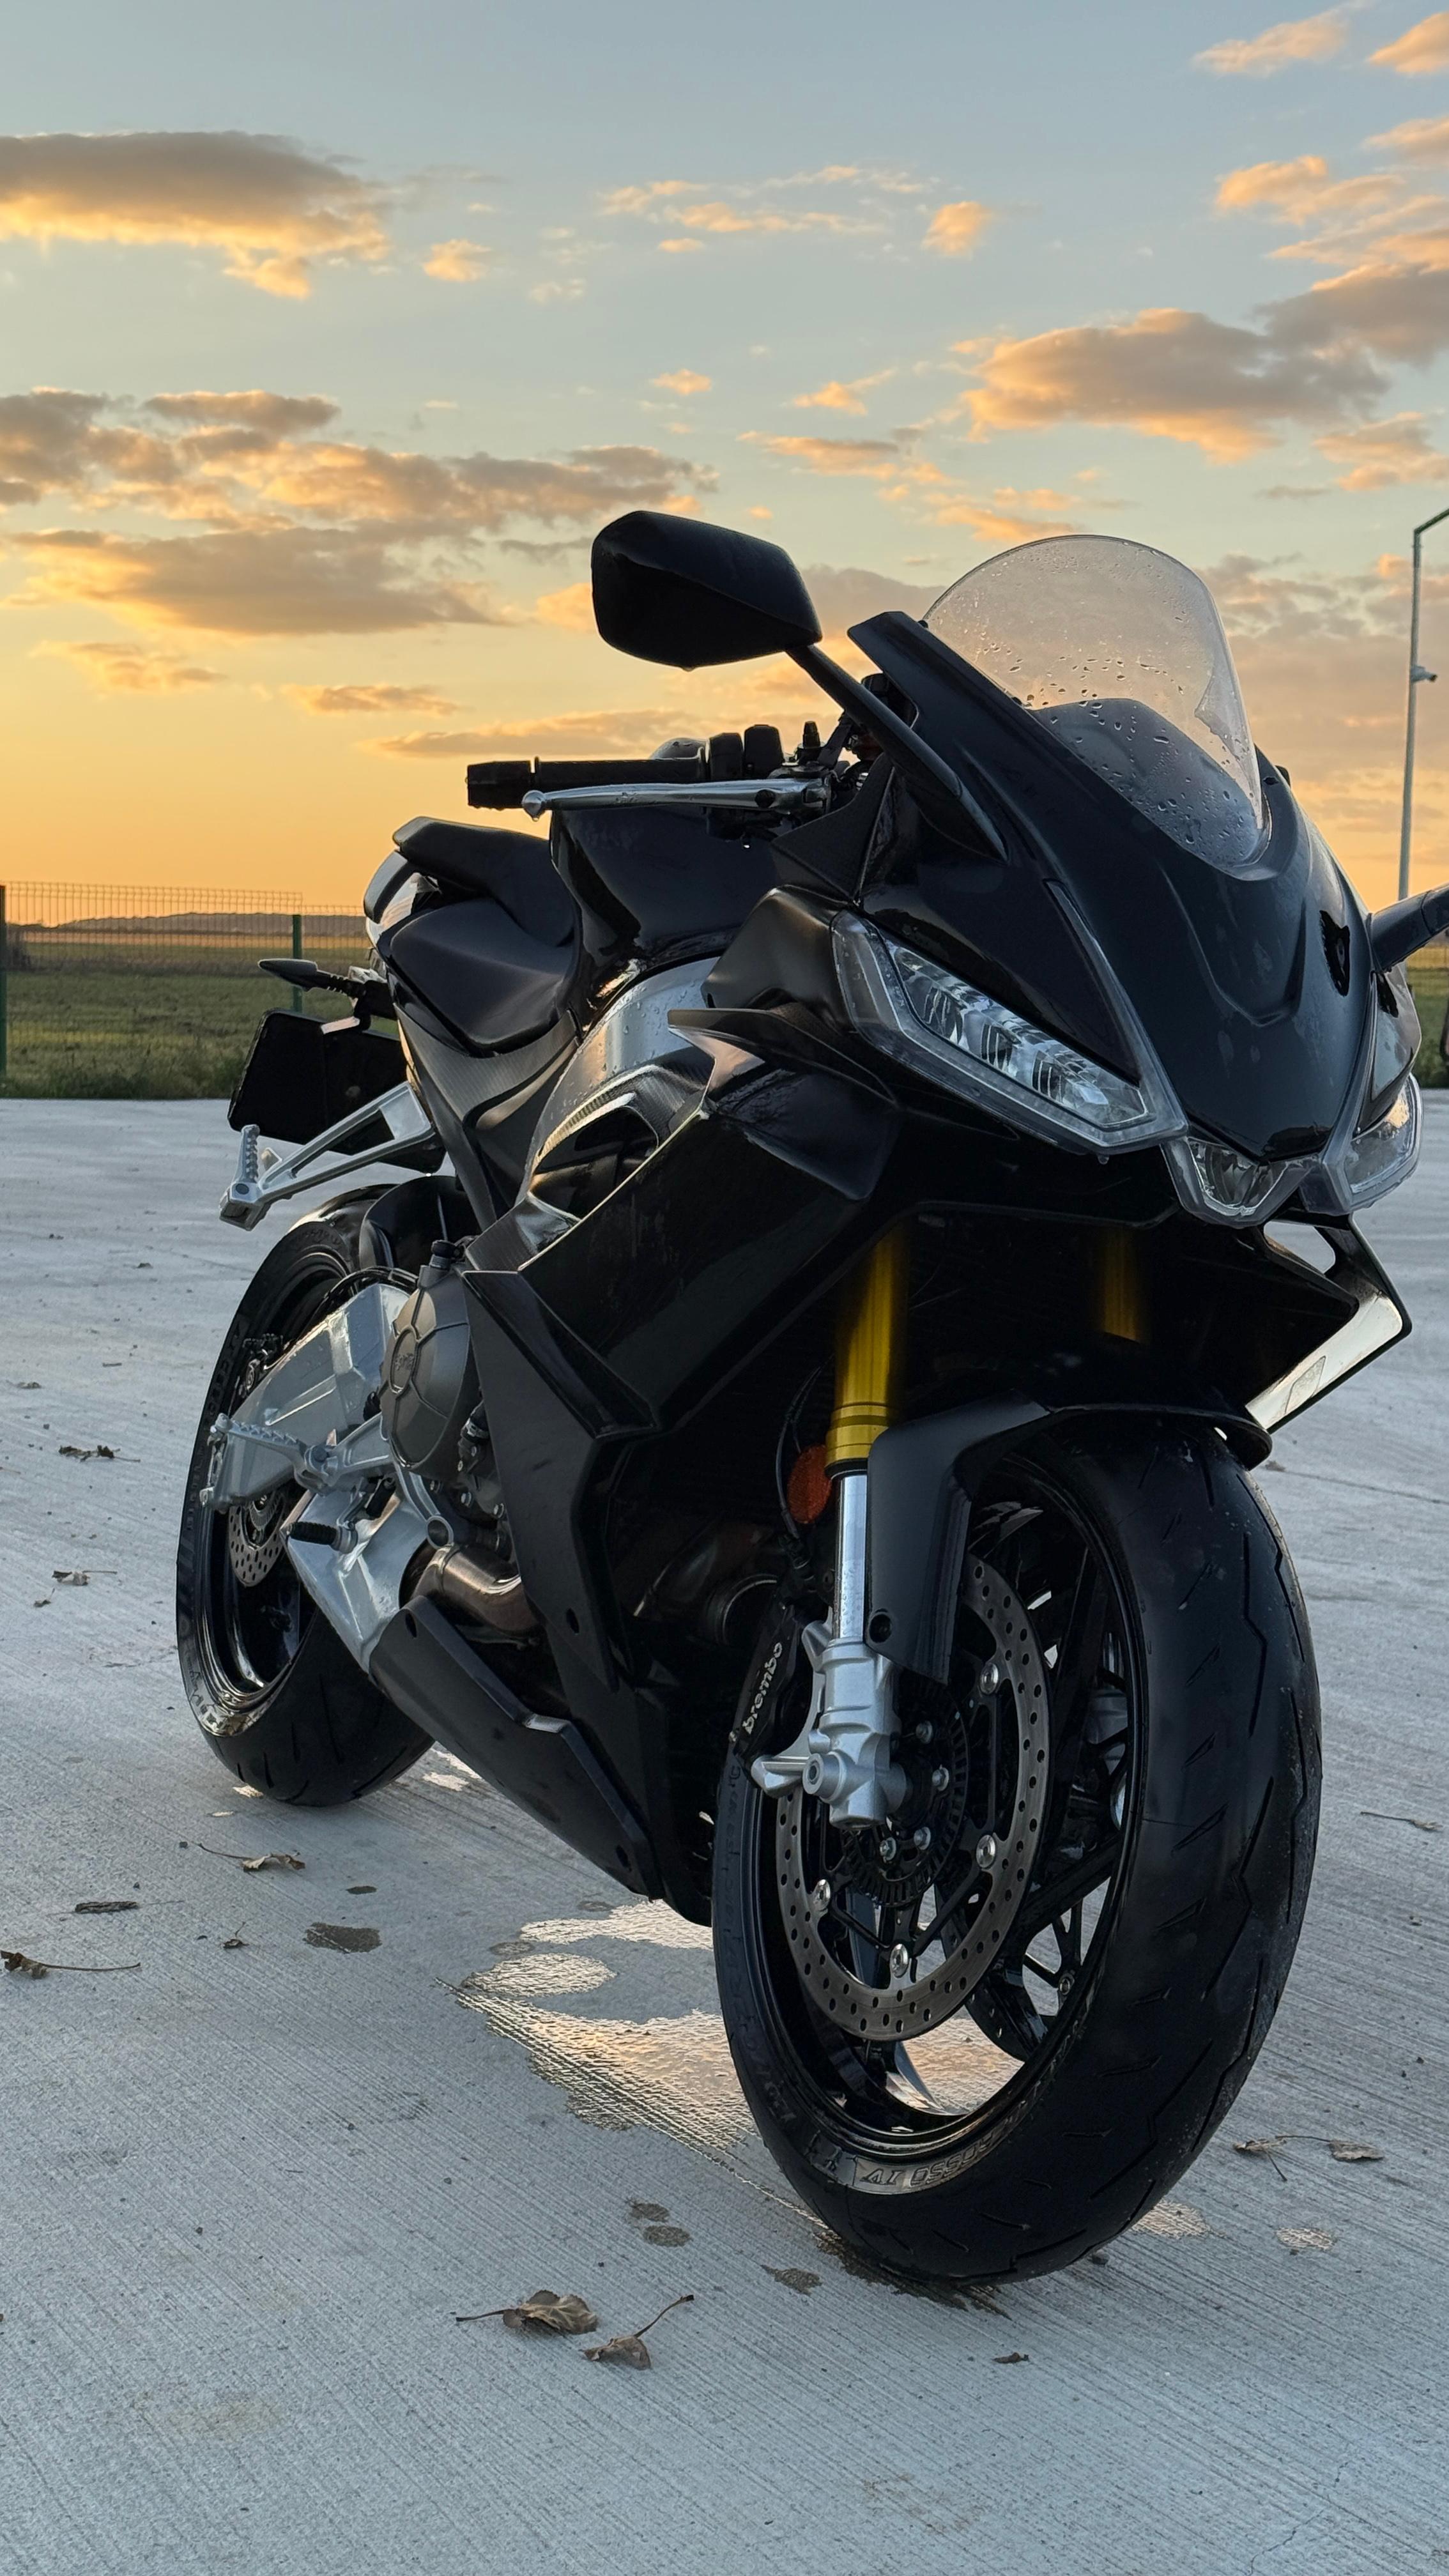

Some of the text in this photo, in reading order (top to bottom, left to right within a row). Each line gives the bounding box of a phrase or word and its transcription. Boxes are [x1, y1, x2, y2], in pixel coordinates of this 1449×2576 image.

[742, 1642, 783, 1734] brembo
[859, 2131, 995, 2187] ROSSO IV
